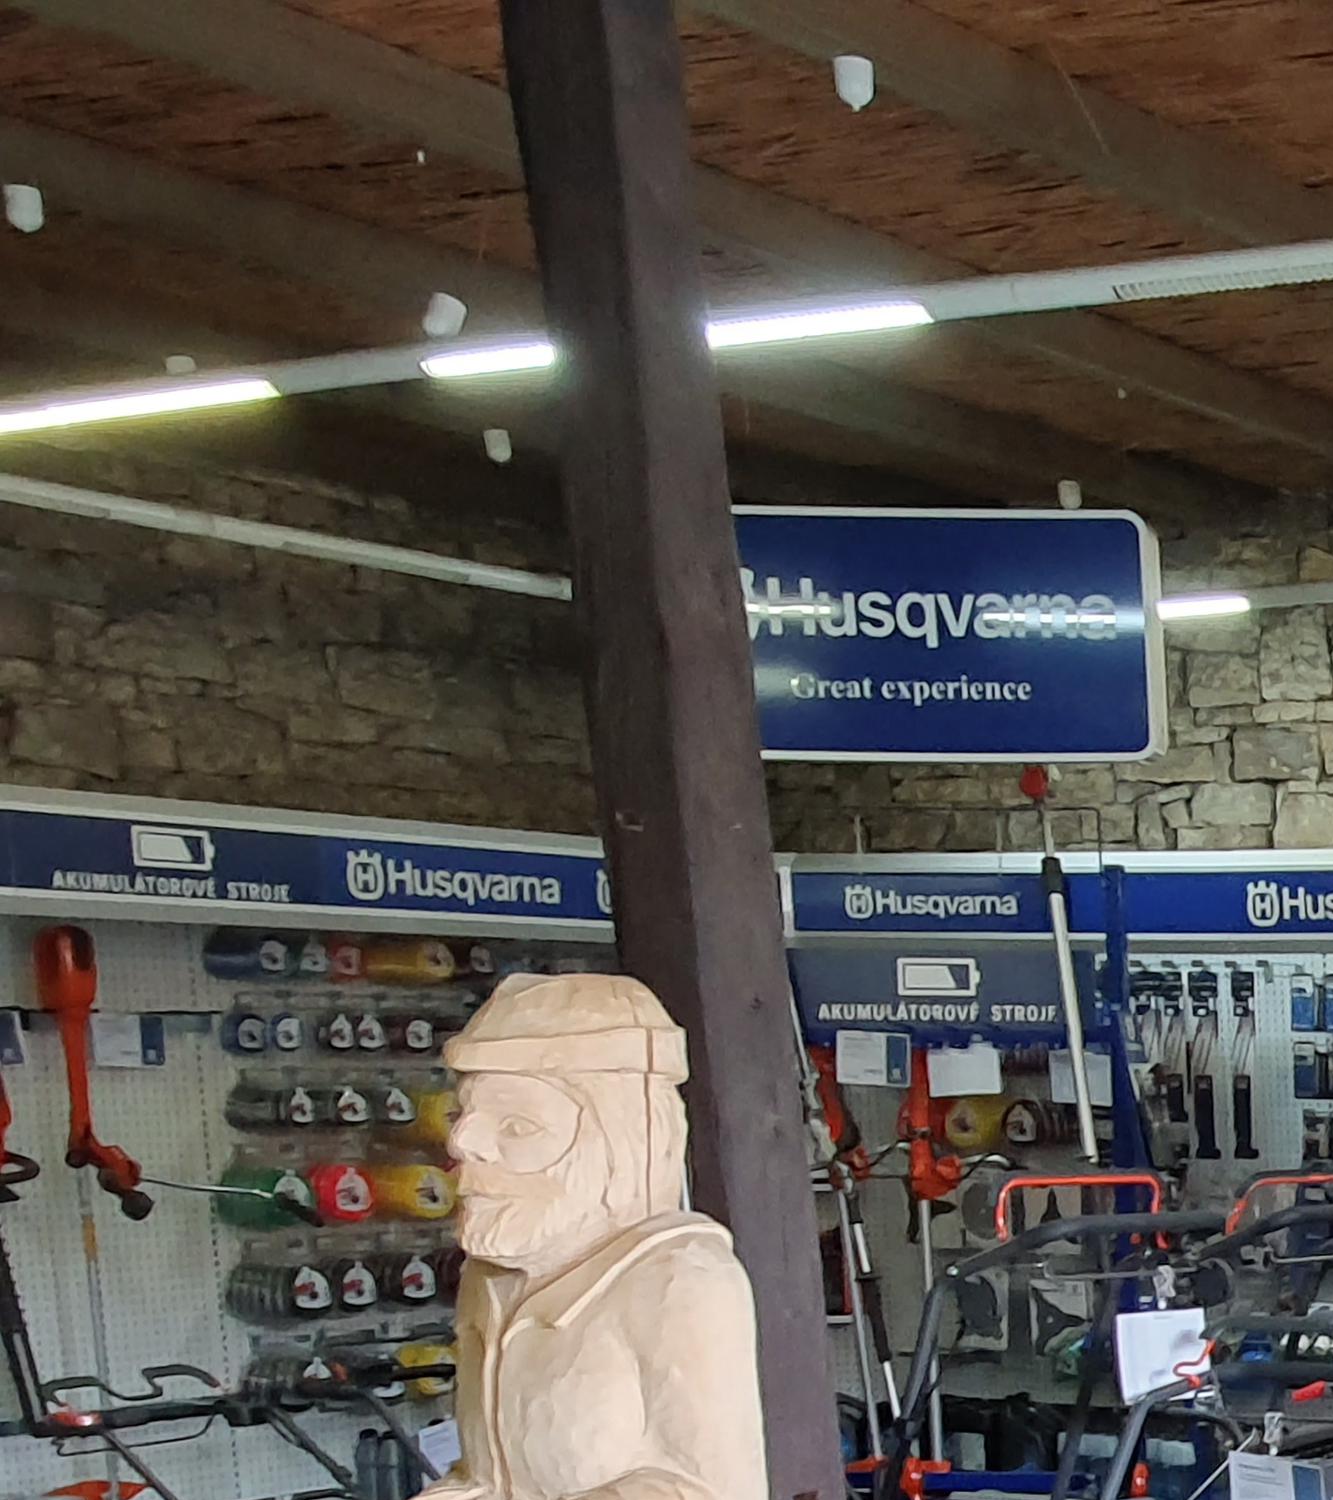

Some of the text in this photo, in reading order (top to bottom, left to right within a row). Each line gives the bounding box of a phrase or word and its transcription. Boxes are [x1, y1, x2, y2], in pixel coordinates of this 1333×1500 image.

[766, 577, 1118, 649] Husqvarna
[791, 675, 1032, 705] Great experience
[226, 880, 293, 904] STROJE
[386, 858, 562, 906] Husqvarna
[875, 888, 1020, 920] Husqvarna
